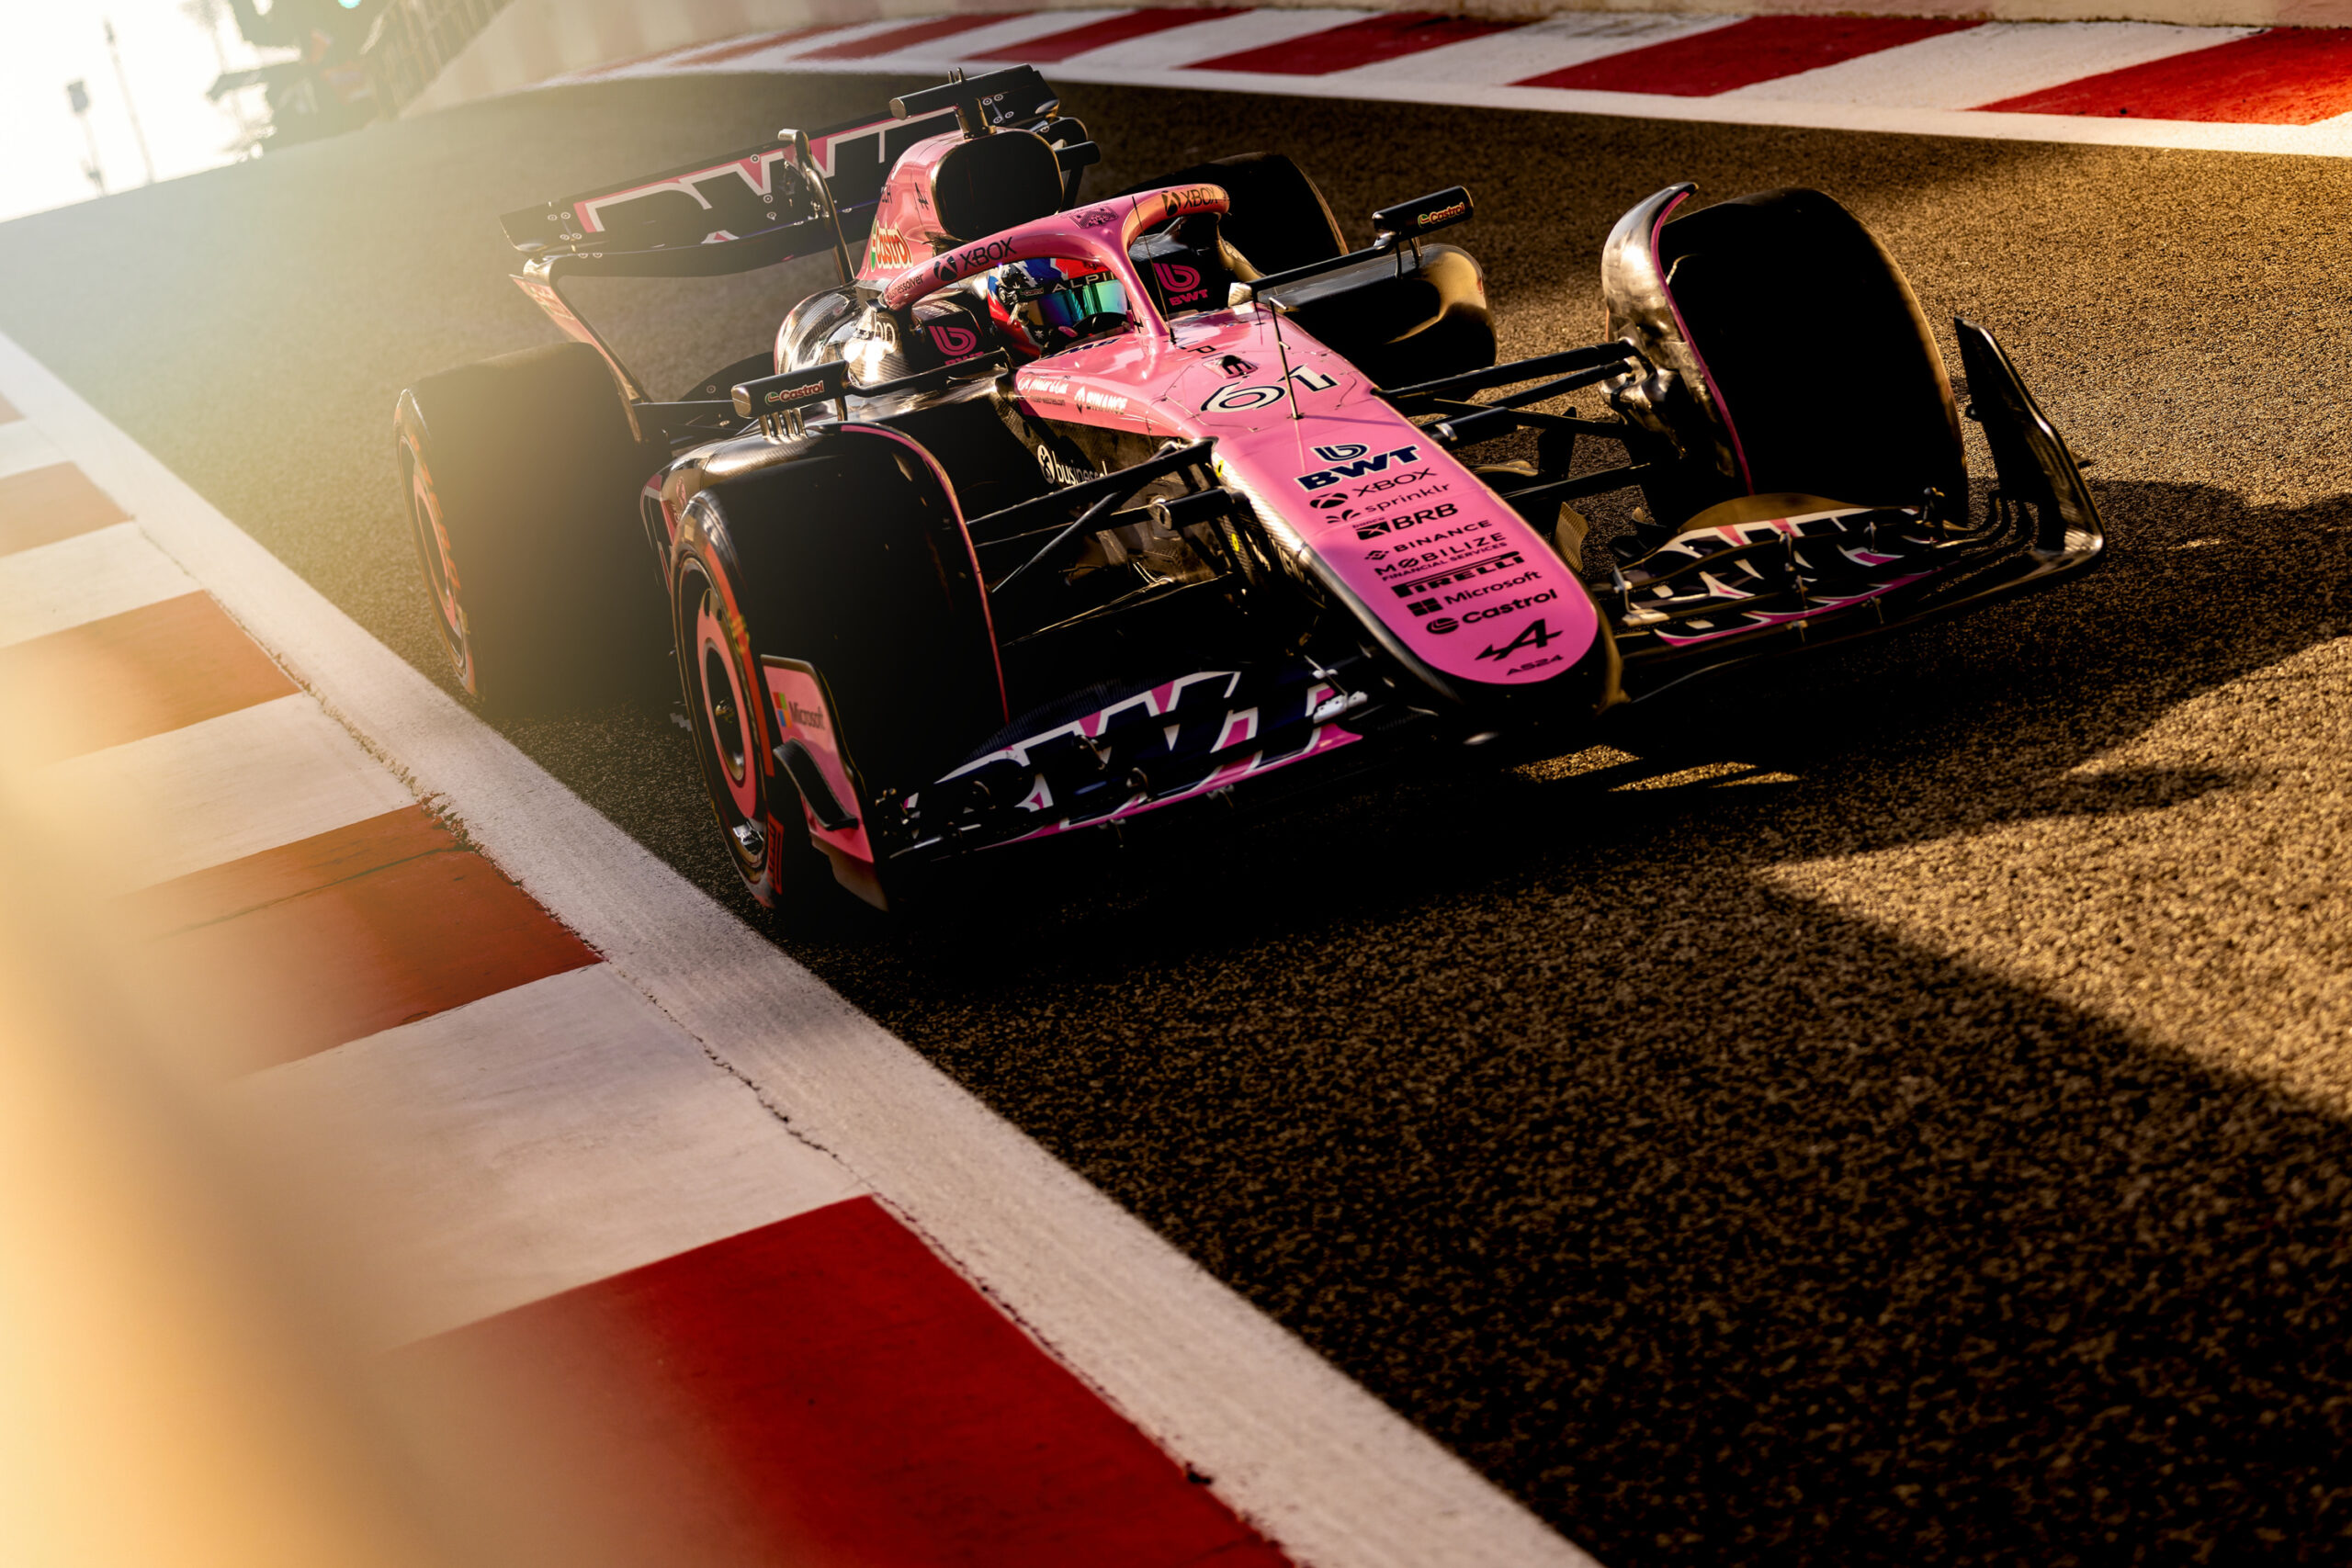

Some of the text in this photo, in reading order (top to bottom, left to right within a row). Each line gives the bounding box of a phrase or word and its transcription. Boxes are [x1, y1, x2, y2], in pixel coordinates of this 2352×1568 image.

[1181, 186, 1218, 209] XBOX
[1430, 201, 1465, 224] Castrol
[876, 220, 913, 268] Castrol
[960, 237, 1017, 270] XBOX
[1169, 289, 1207, 306] BWT
[779, 380, 824, 402] Castrol
[1086, 391, 1128, 415] BINANCE
[1294, 444, 1421, 491] BWT
[1352, 468, 1437, 497] XBOX
[1365, 483, 1450, 512] sprinklr
[1392, 503, 1458, 530] BRB
[1394, 519, 1493, 552] BINANCE
[1382, 542, 1508, 581] FINANCIAL SERVICES
[1391, 551, 1525, 597] PIRELLI
[1443, 570, 1543, 604] Microsoft
[1462, 589, 1558, 623] Castrol
[788, 701, 825, 730] Microsoft
